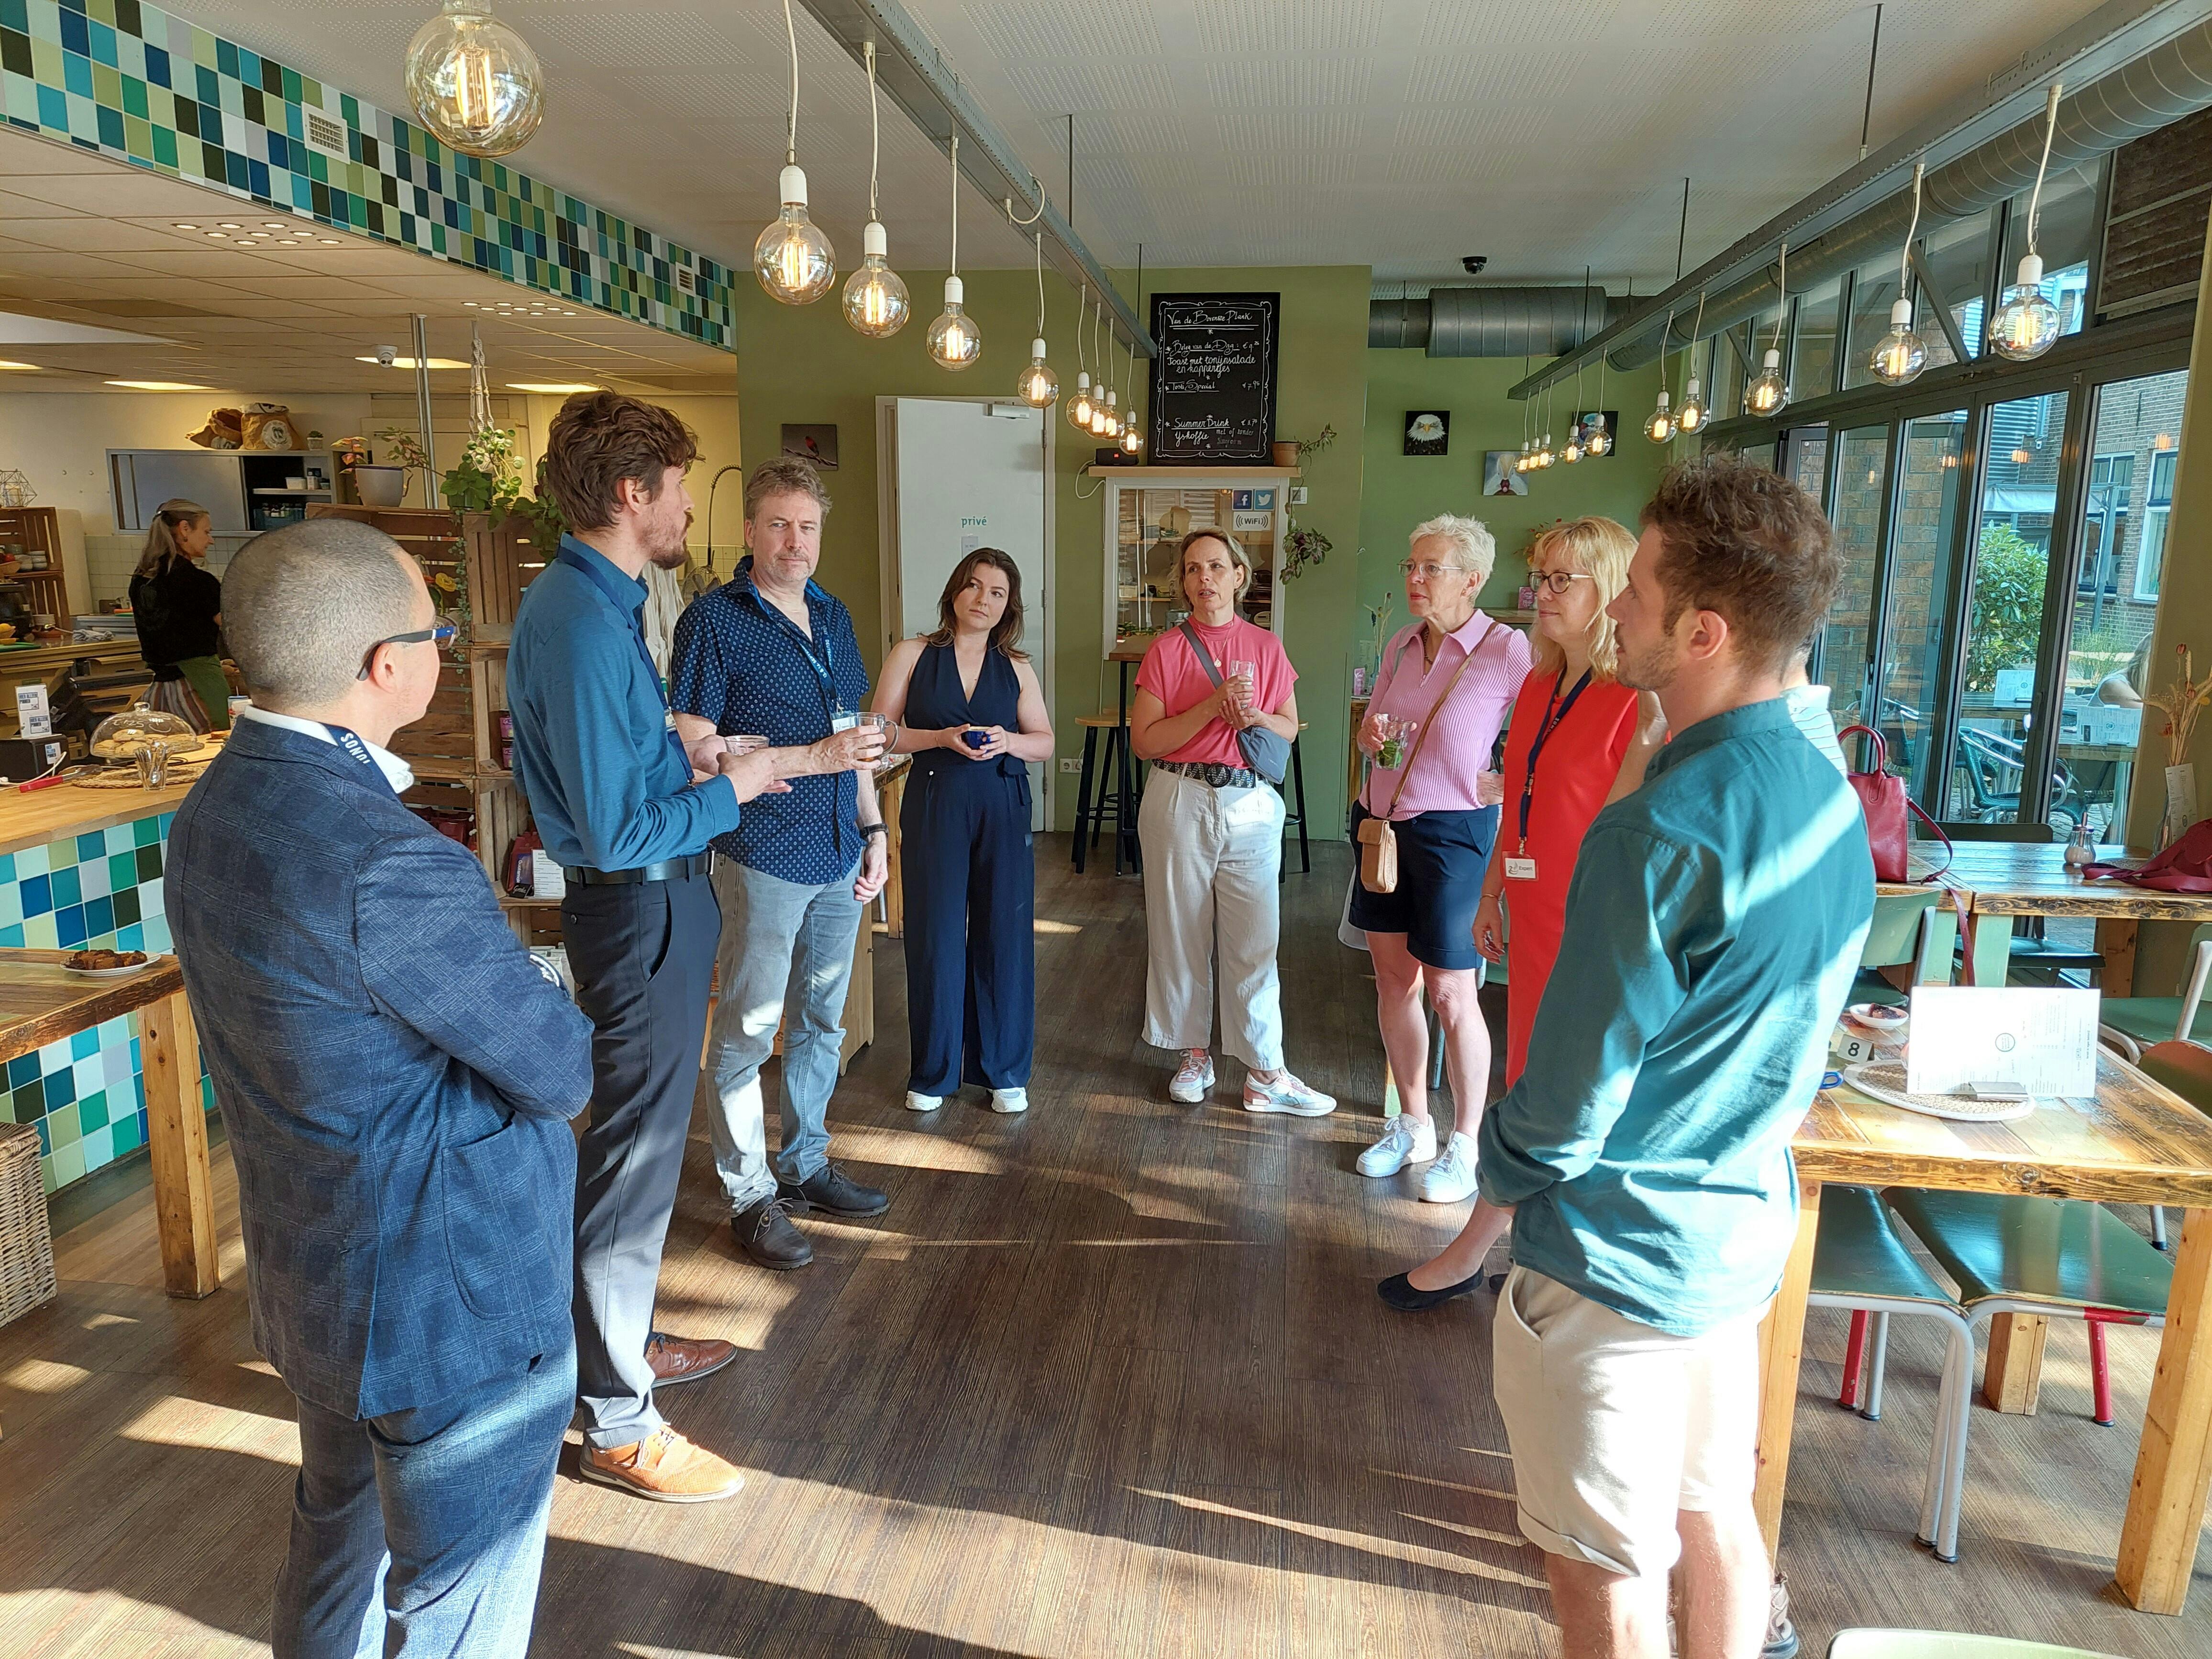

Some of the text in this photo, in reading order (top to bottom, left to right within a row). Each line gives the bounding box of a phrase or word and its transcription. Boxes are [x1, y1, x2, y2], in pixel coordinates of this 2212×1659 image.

[1167, 310, 1252, 325] Van de Bovenste Plank
[1167, 357, 1188, 365] Toast
[1187, 364, 1230, 378] kappertjes
[1167, 381, 1184, 390] Tosti
[1184, 379, 1216, 392] Special
[1174, 418, 1206, 428] Summer
[1206, 418, 1229, 427] Drink
[1228, 428, 1235, 437] of
[961, 516, 987, 528] privé
[1848, 1042, 1860, 1057] 8
